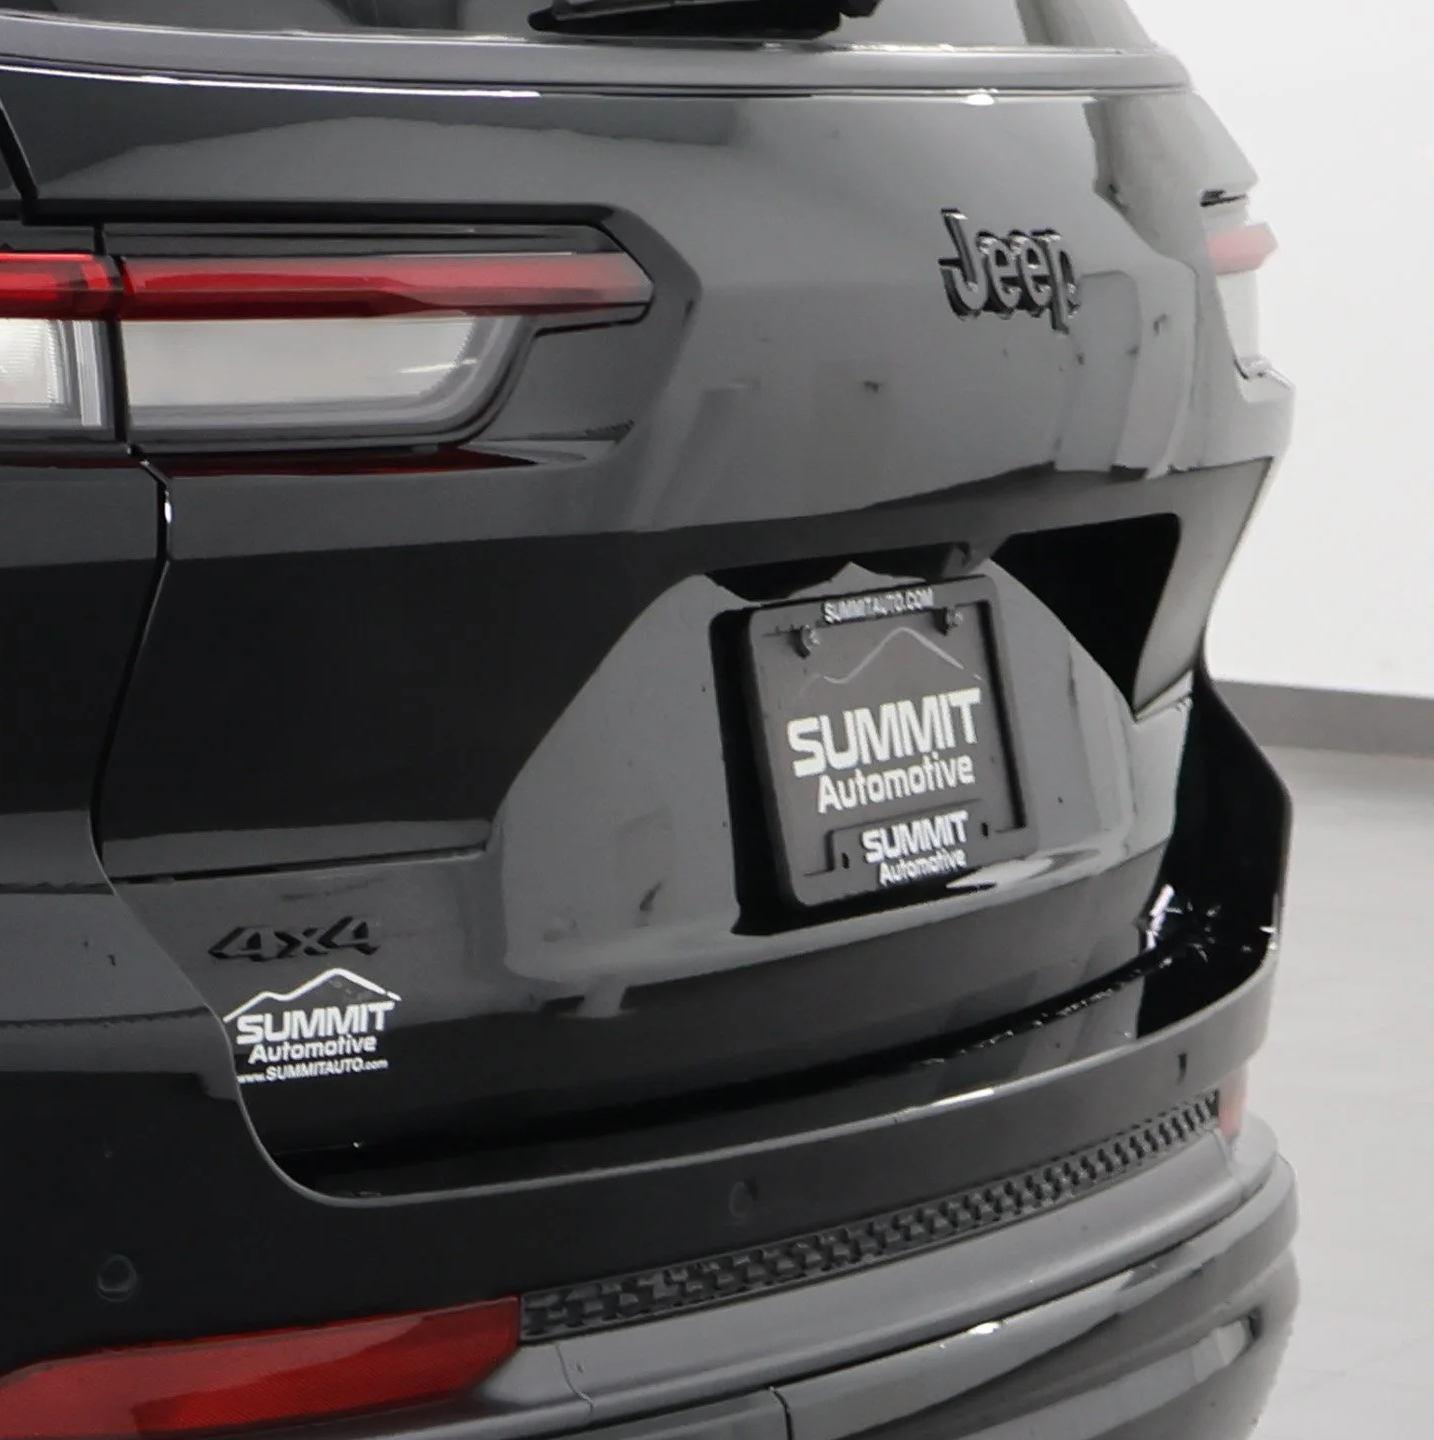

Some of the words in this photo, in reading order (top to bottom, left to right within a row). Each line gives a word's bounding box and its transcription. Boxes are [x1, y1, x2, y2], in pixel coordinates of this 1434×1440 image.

[938, 209, 1080, 333] Jeep
[824, 587, 934, 623] SUMMITAUTO.COM
[787, 688, 981, 777] SUMMIT
[818, 753, 975, 813] Automotive
[862, 810, 969, 863] SUMMIT
[880, 848, 967, 887] Automotive
[236, 1001, 395, 1045] SUMMIT
[237, 1057, 389, 1084] www.SUMMITAUTO.com
[248, 1034, 377, 1064] Automotive
